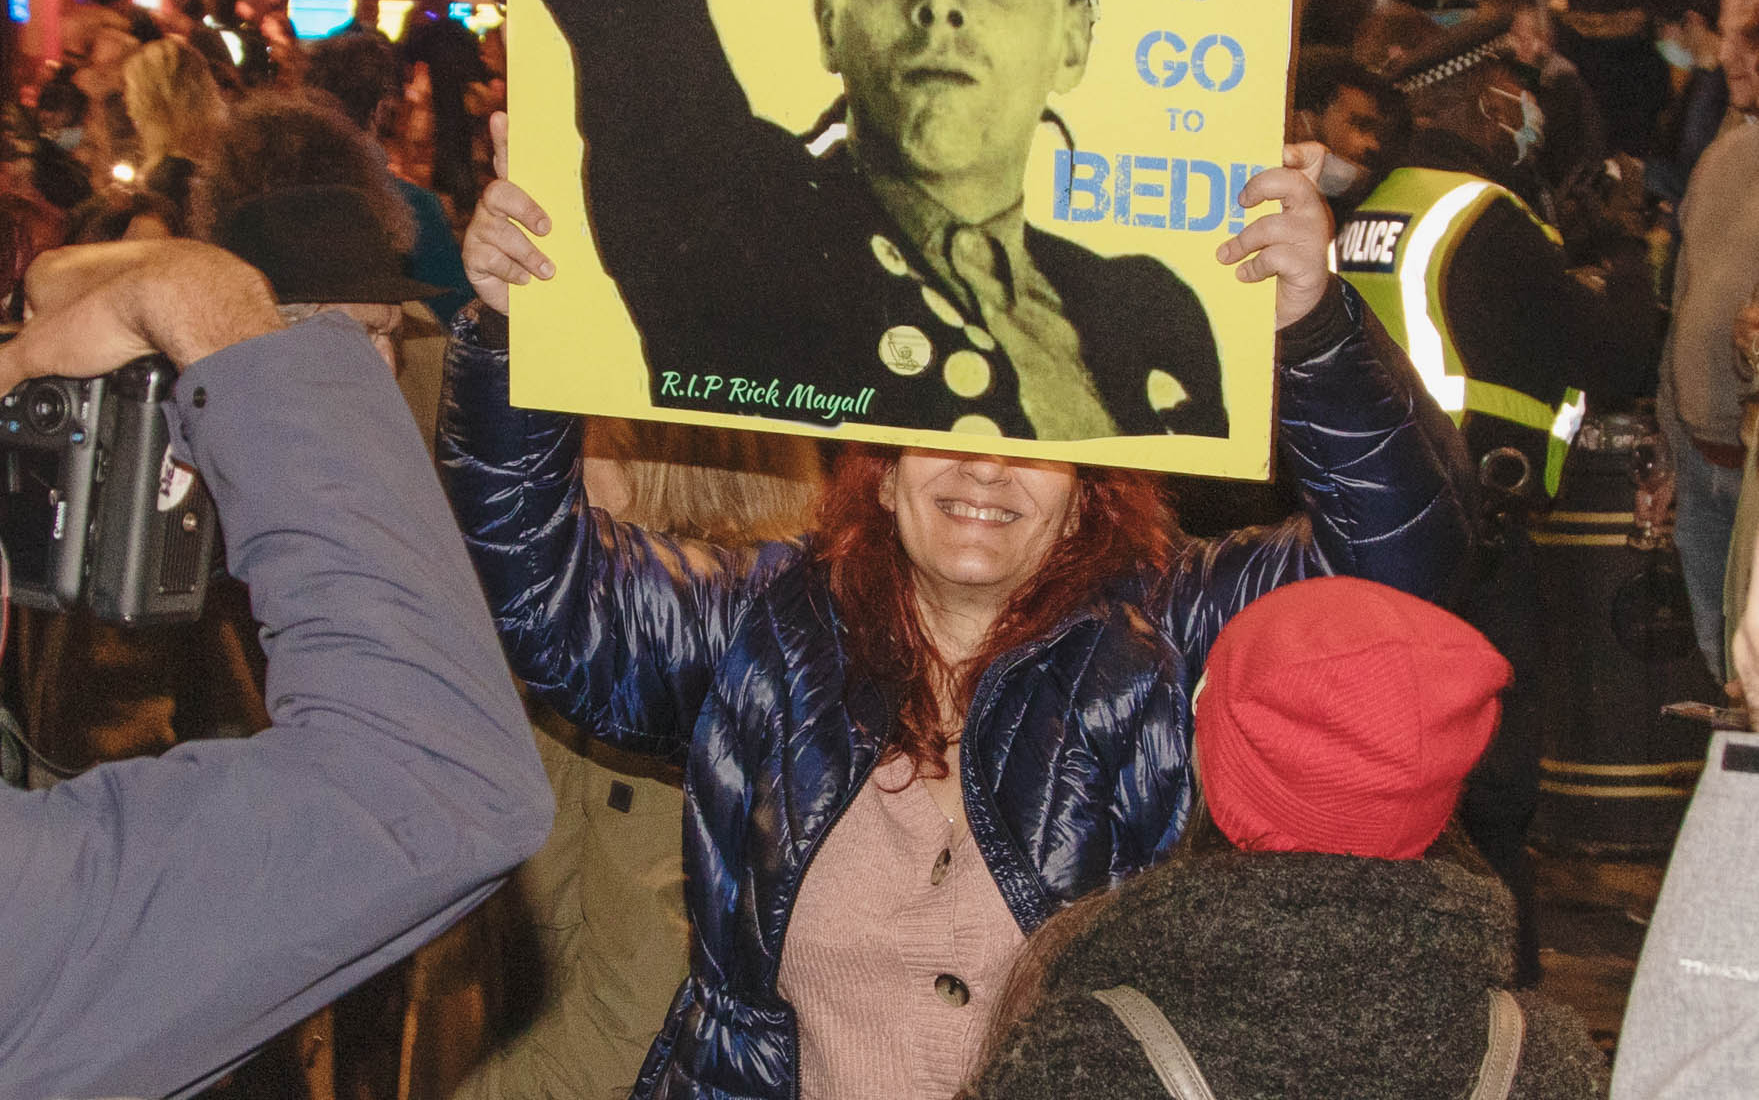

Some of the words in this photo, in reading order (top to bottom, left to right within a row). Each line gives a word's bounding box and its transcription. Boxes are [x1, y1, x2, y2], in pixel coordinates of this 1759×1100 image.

[1134, 29, 1246, 93] GO
[1165, 107, 1205, 133] TO
[660, 370, 724, 400] R.I.P
[728, 377, 780, 408] Rick
[785, 383, 876, 420] Mayall
[53, 501, 67, 540] Canon
